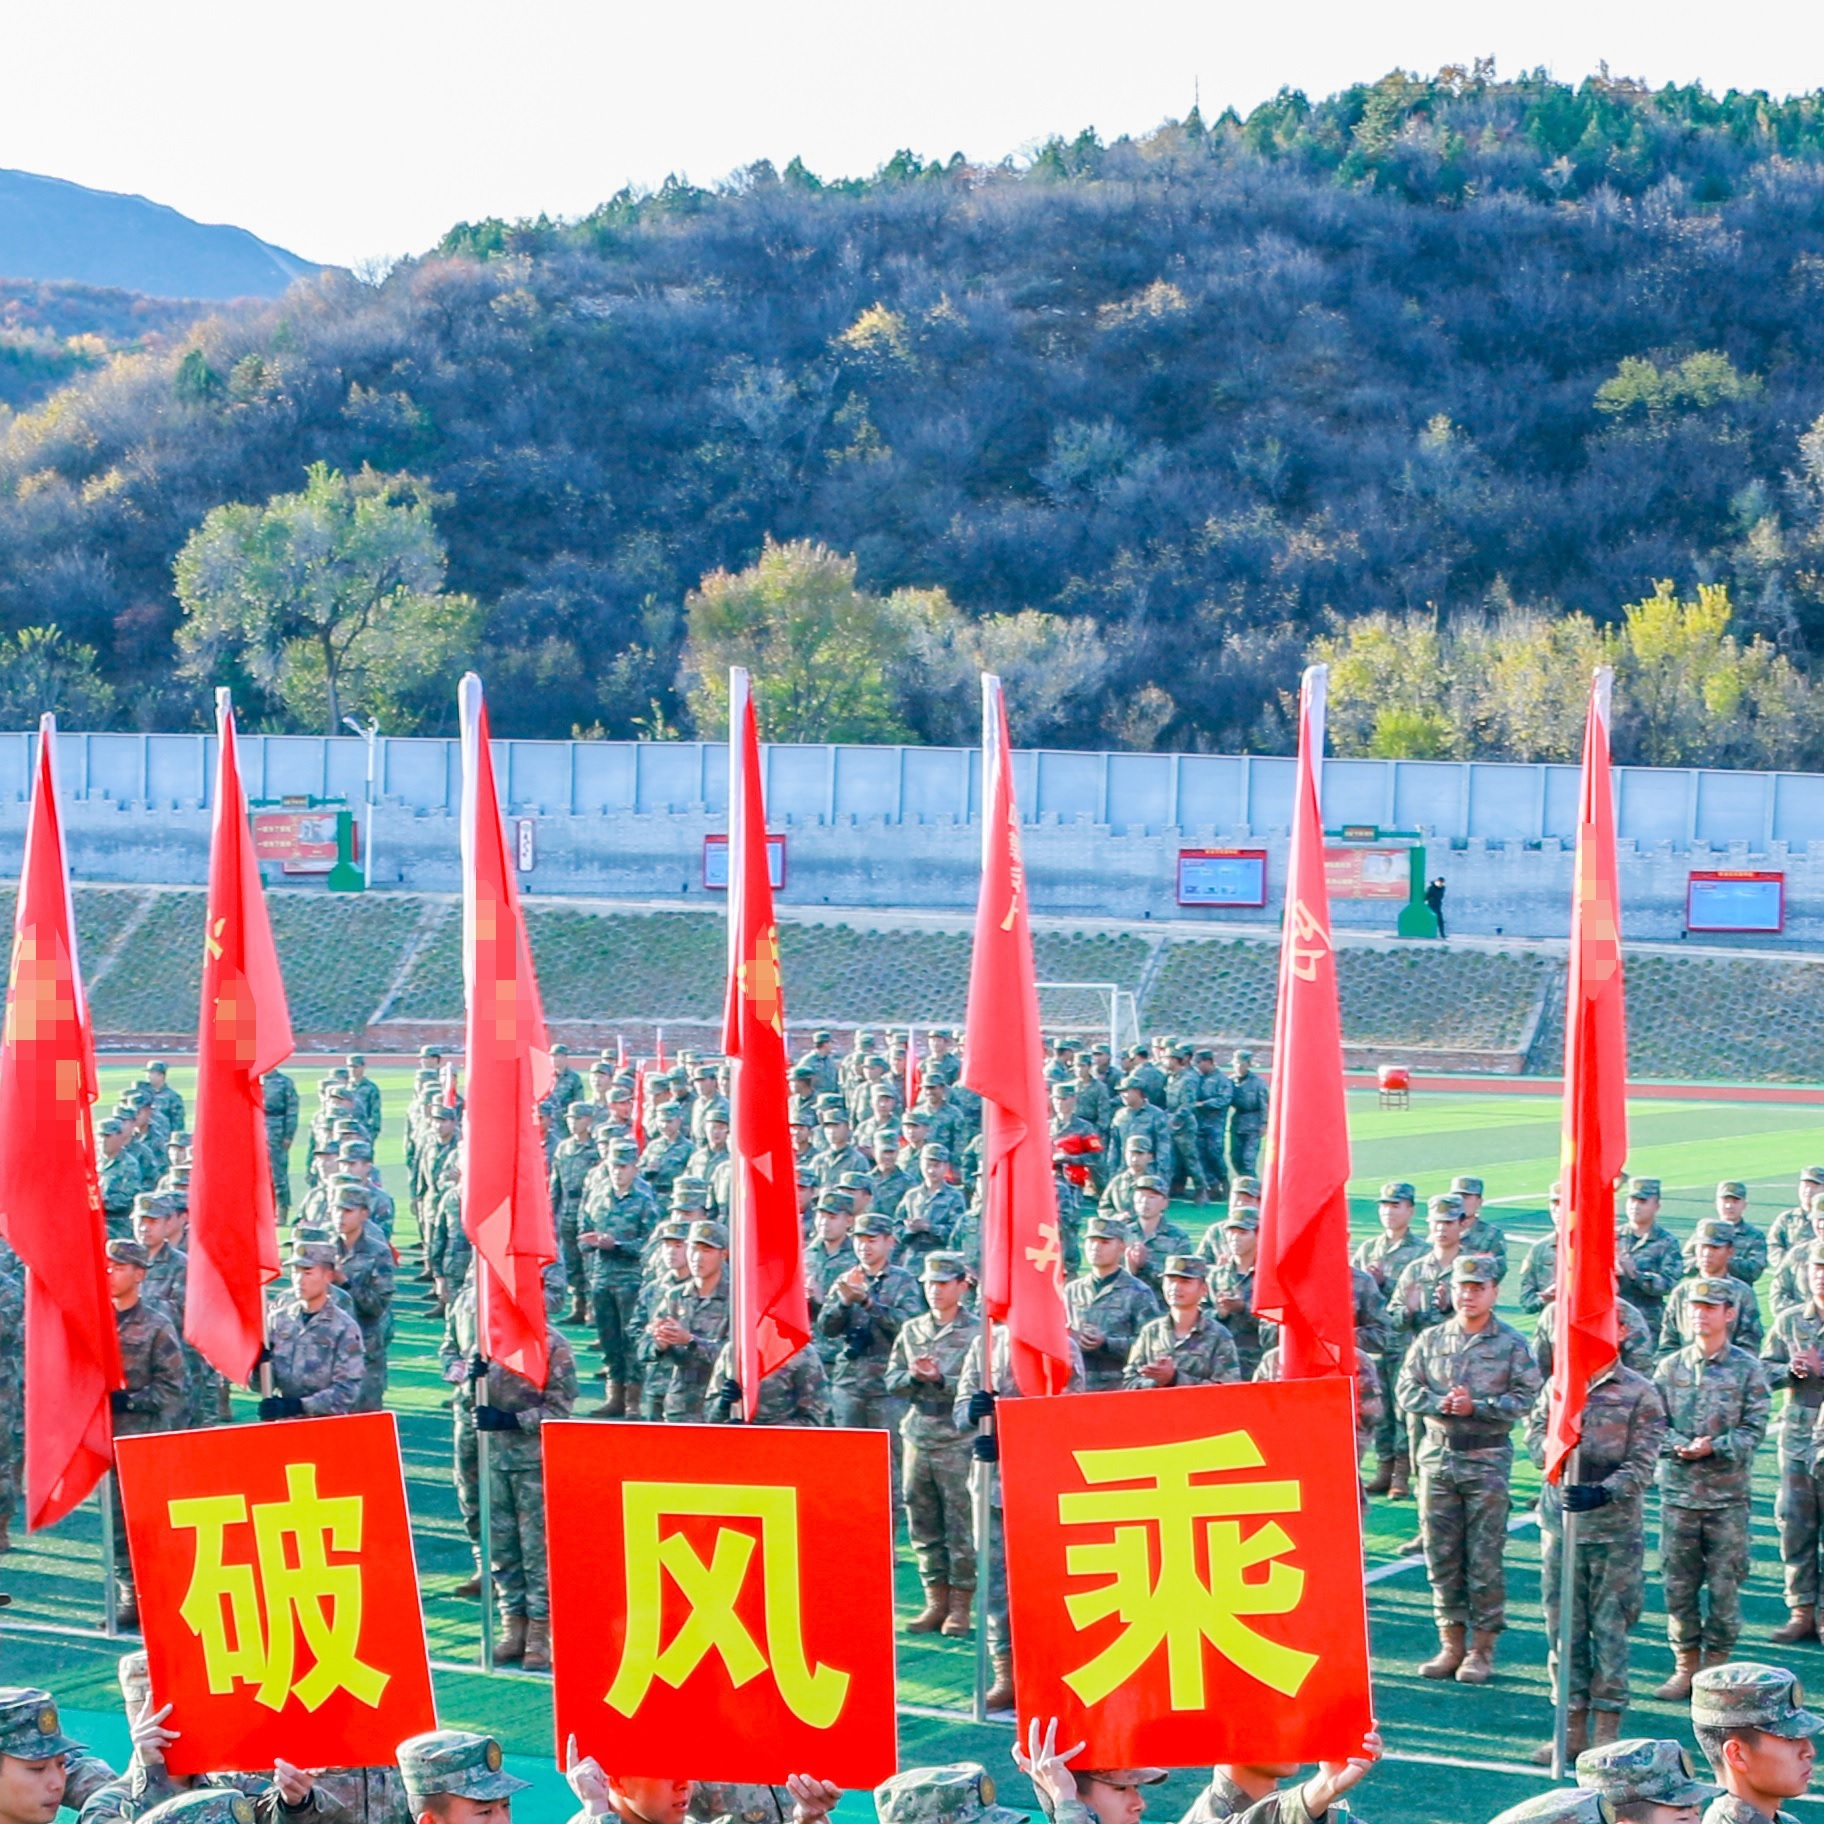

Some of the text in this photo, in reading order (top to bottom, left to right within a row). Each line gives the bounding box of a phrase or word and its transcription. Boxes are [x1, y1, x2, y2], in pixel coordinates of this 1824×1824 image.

[168, 1470, 389, 1710] 破
[606, 1481, 850, 1727] 风
[1060, 1432, 1318, 1709] 乘
